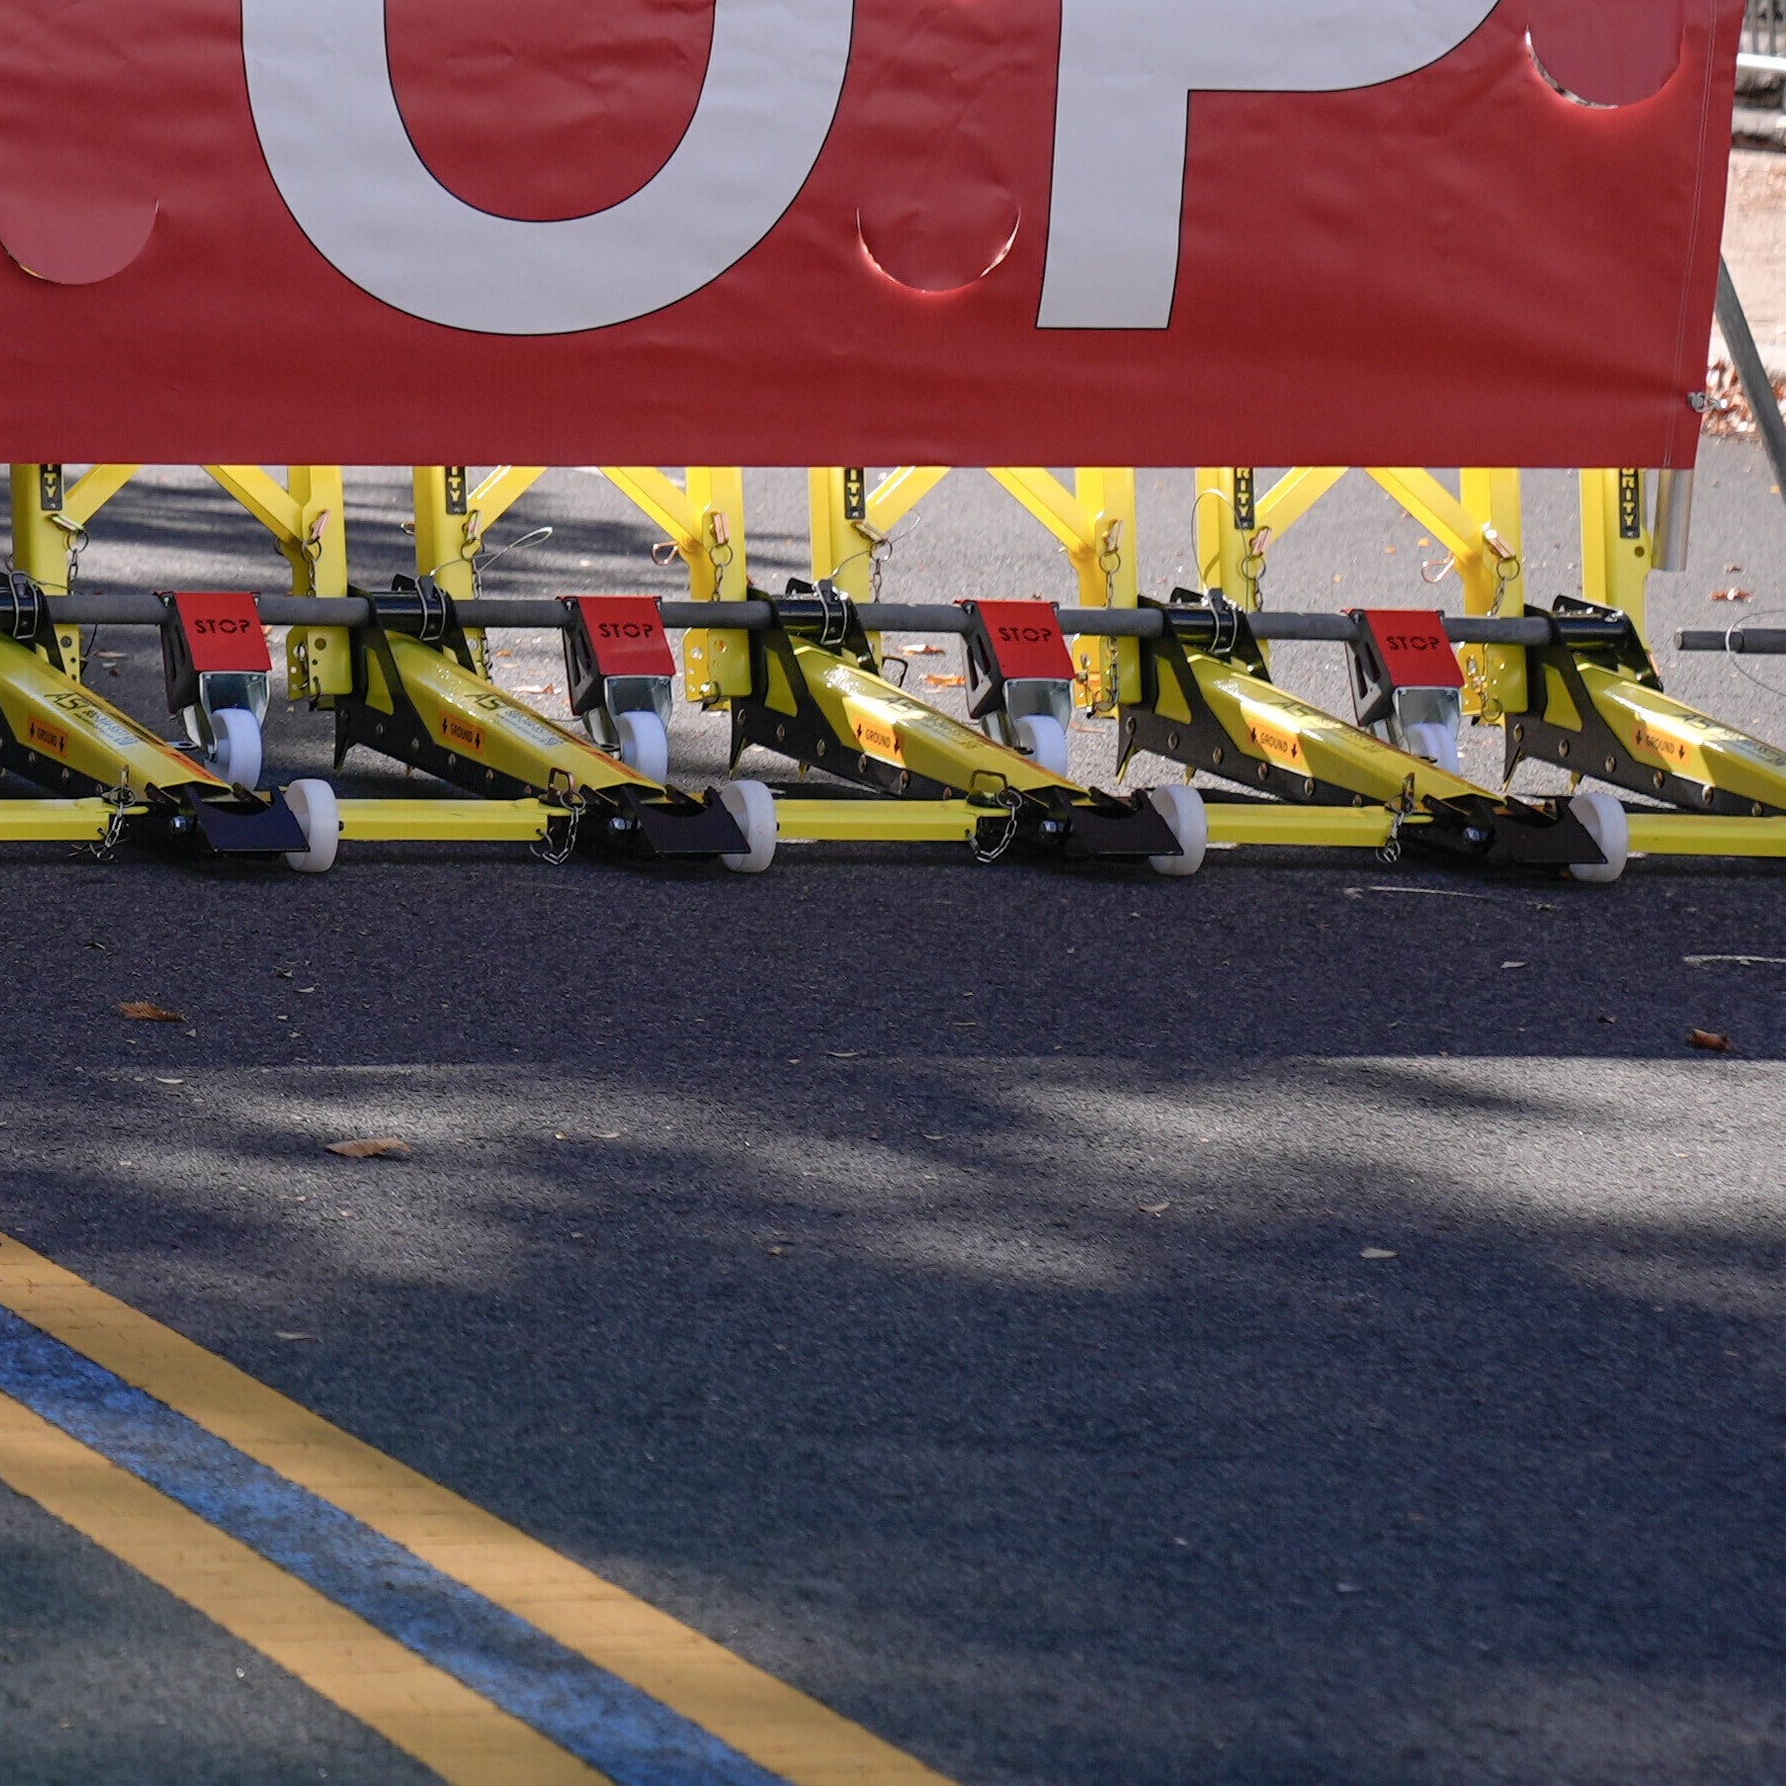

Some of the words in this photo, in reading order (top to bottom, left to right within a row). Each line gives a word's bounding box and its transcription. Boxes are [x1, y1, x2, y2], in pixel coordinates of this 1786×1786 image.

[448, 466, 463, 503] ITY
[846, 467, 861, 507] ITY
[1235, 467, 1251, 519] RITY
[1620, 467, 1636, 527] RITY
[193, 617, 251, 635] STOP
[597, 622, 654, 639] STOP
[997, 625, 1053, 643] STOP
[1385, 635, 1441, 652] STOP
[36, 725, 59, 750] GROUND
[448, 722, 474, 746] GROUND
[864, 726, 892, 751] GROUND
[1259, 730, 1289, 755] GROUND
